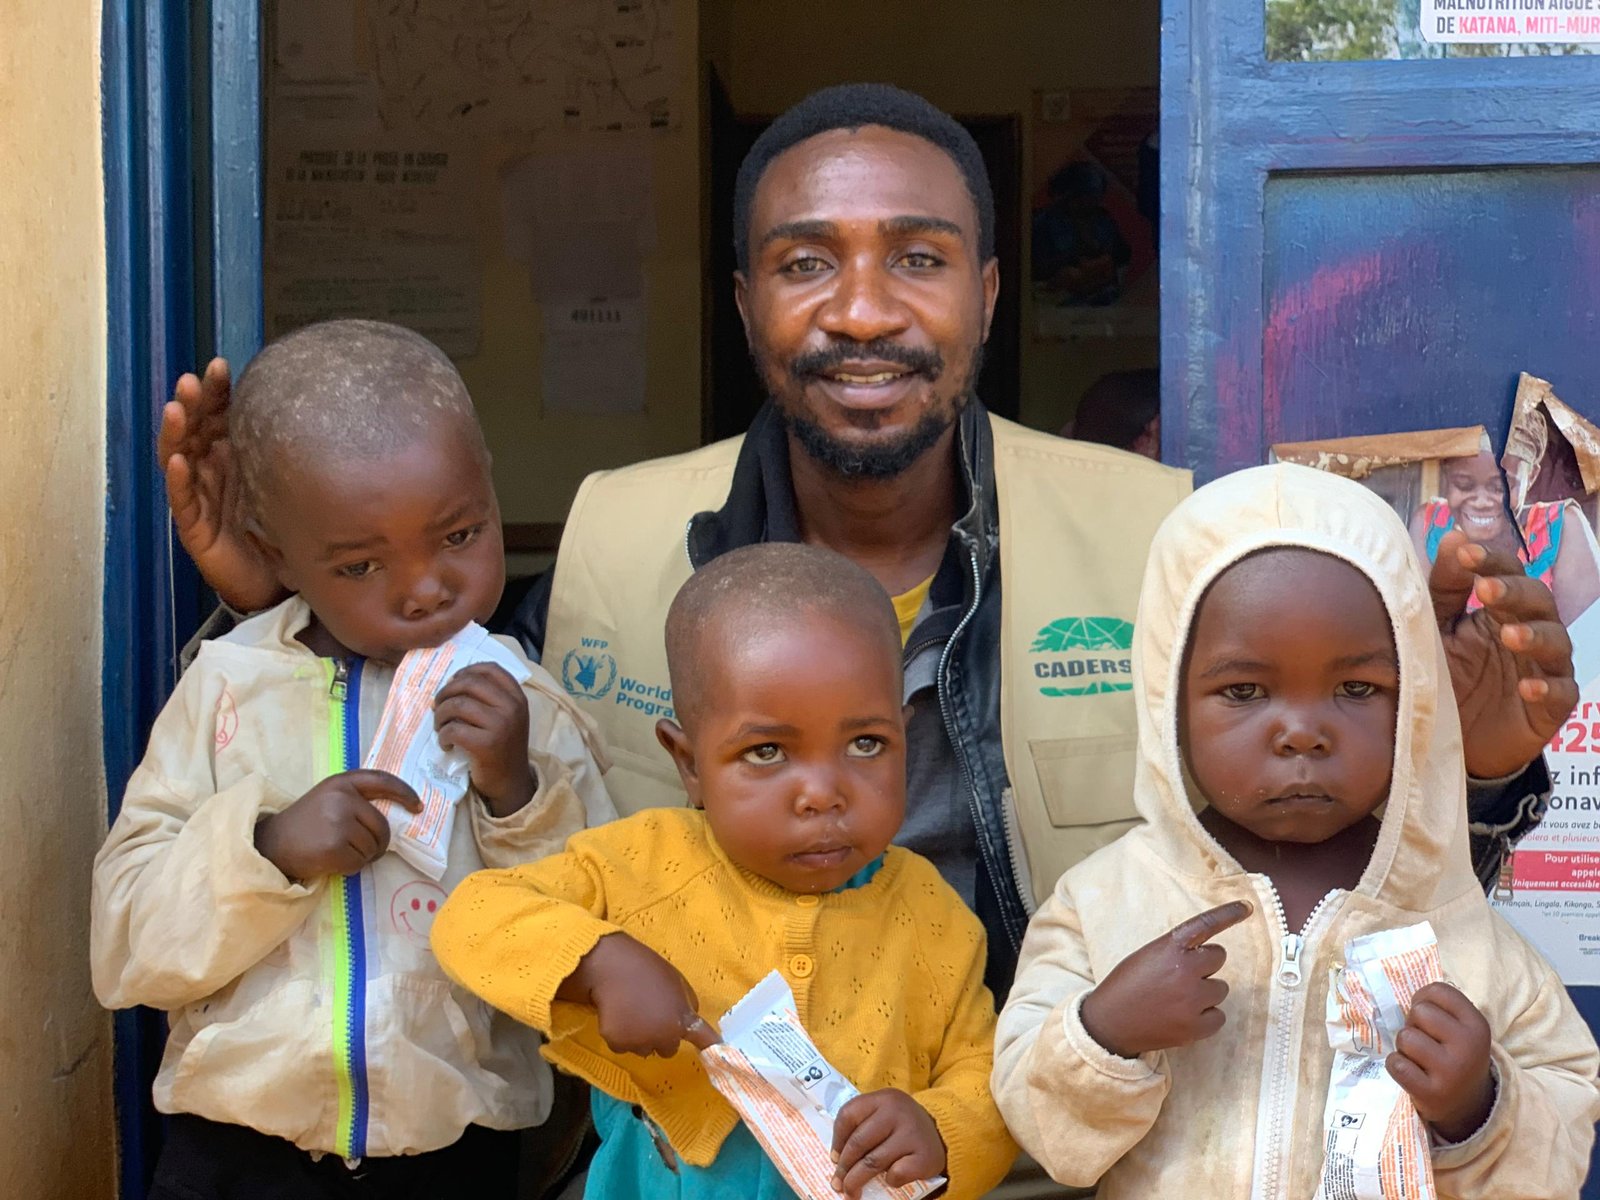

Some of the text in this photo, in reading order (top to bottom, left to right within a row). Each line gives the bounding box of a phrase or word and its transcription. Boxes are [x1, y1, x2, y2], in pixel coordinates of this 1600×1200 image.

[1437, 16, 1455, 34] DE
[1459, 16, 1521, 36] KATANA,
[581, 637, 609, 649] WFP
[1034, 659, 1131, 678] CADERS
[620, 677, 673, 701] World
[616, 691, 676, 719] Progra
[1571, 822, 1591, 830] avez
[1551, 833, 1560, 841] et
[1562, 832, 1600, 844] plusieurs
[1544, 853, 1568, 864] Pour
[1512, 878, 1600, 889] Uniquement accessible
